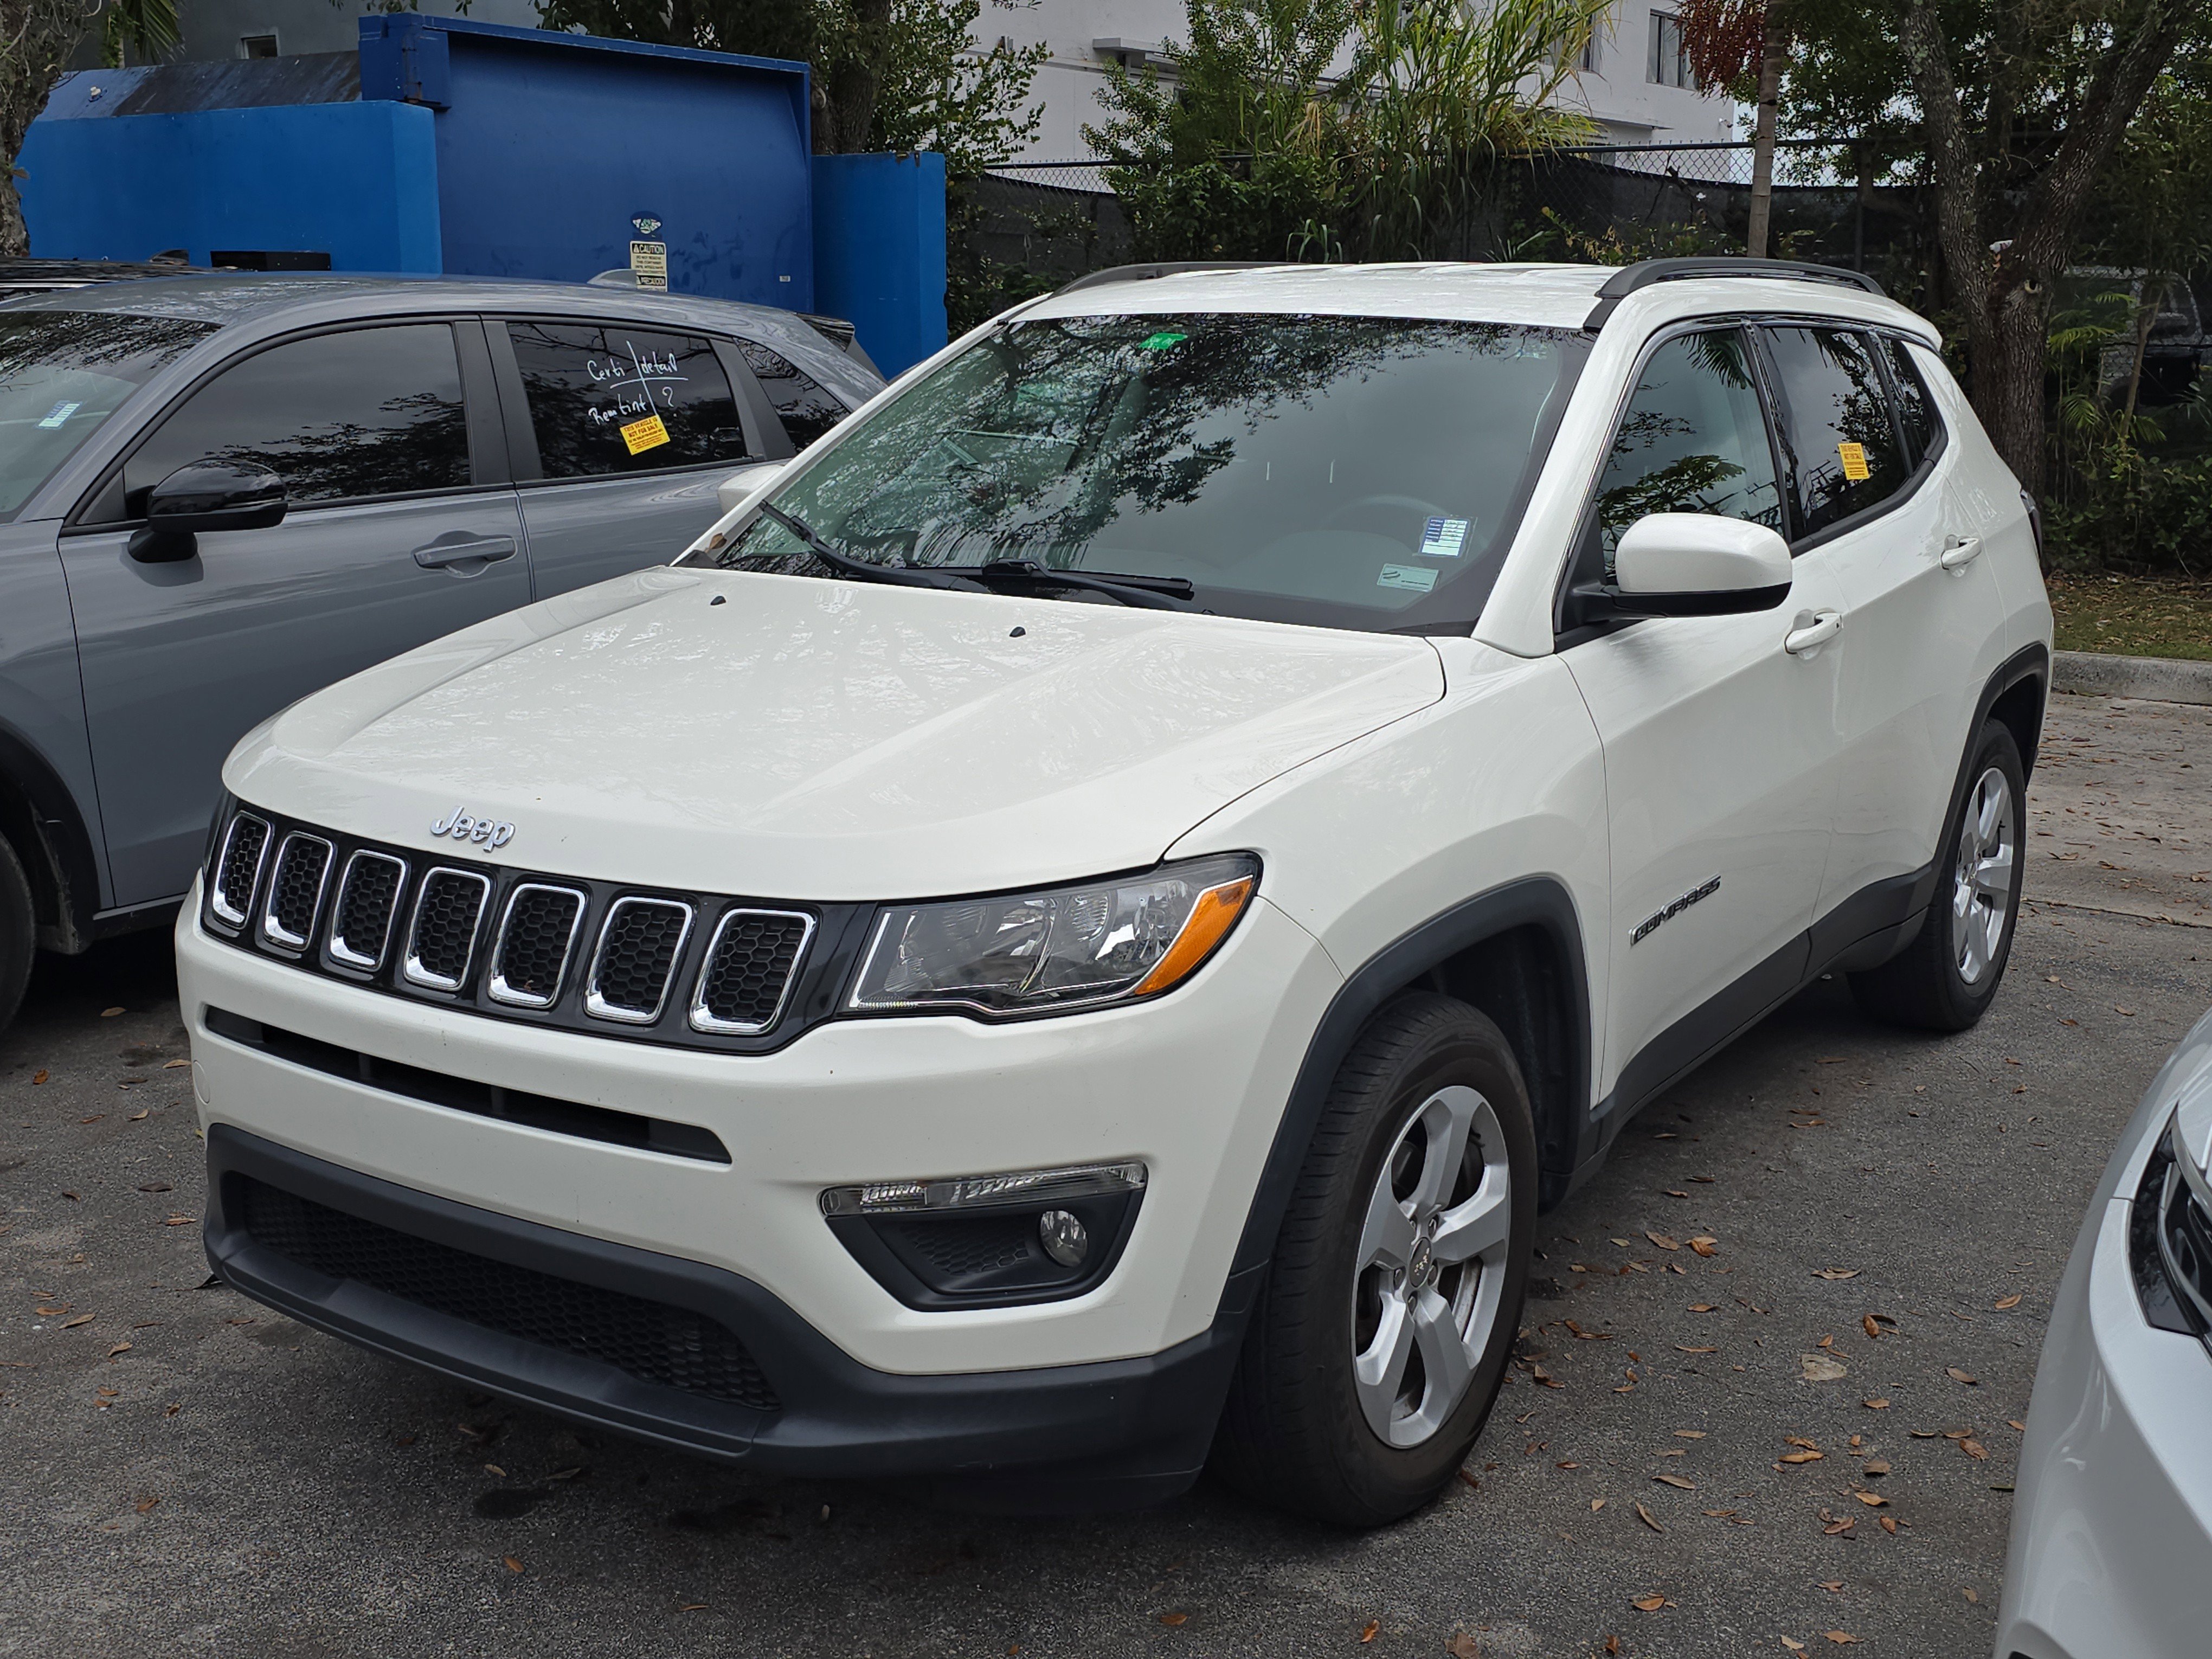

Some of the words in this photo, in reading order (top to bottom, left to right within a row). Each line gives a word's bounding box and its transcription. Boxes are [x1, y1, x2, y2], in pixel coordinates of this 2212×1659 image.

[639, 244, 664, 254] CAUTION
[662, 386, 678, 417] ?
[430, 806, 516, 853] Jeep
[1629, 873, 1721, 947] COMPASS
